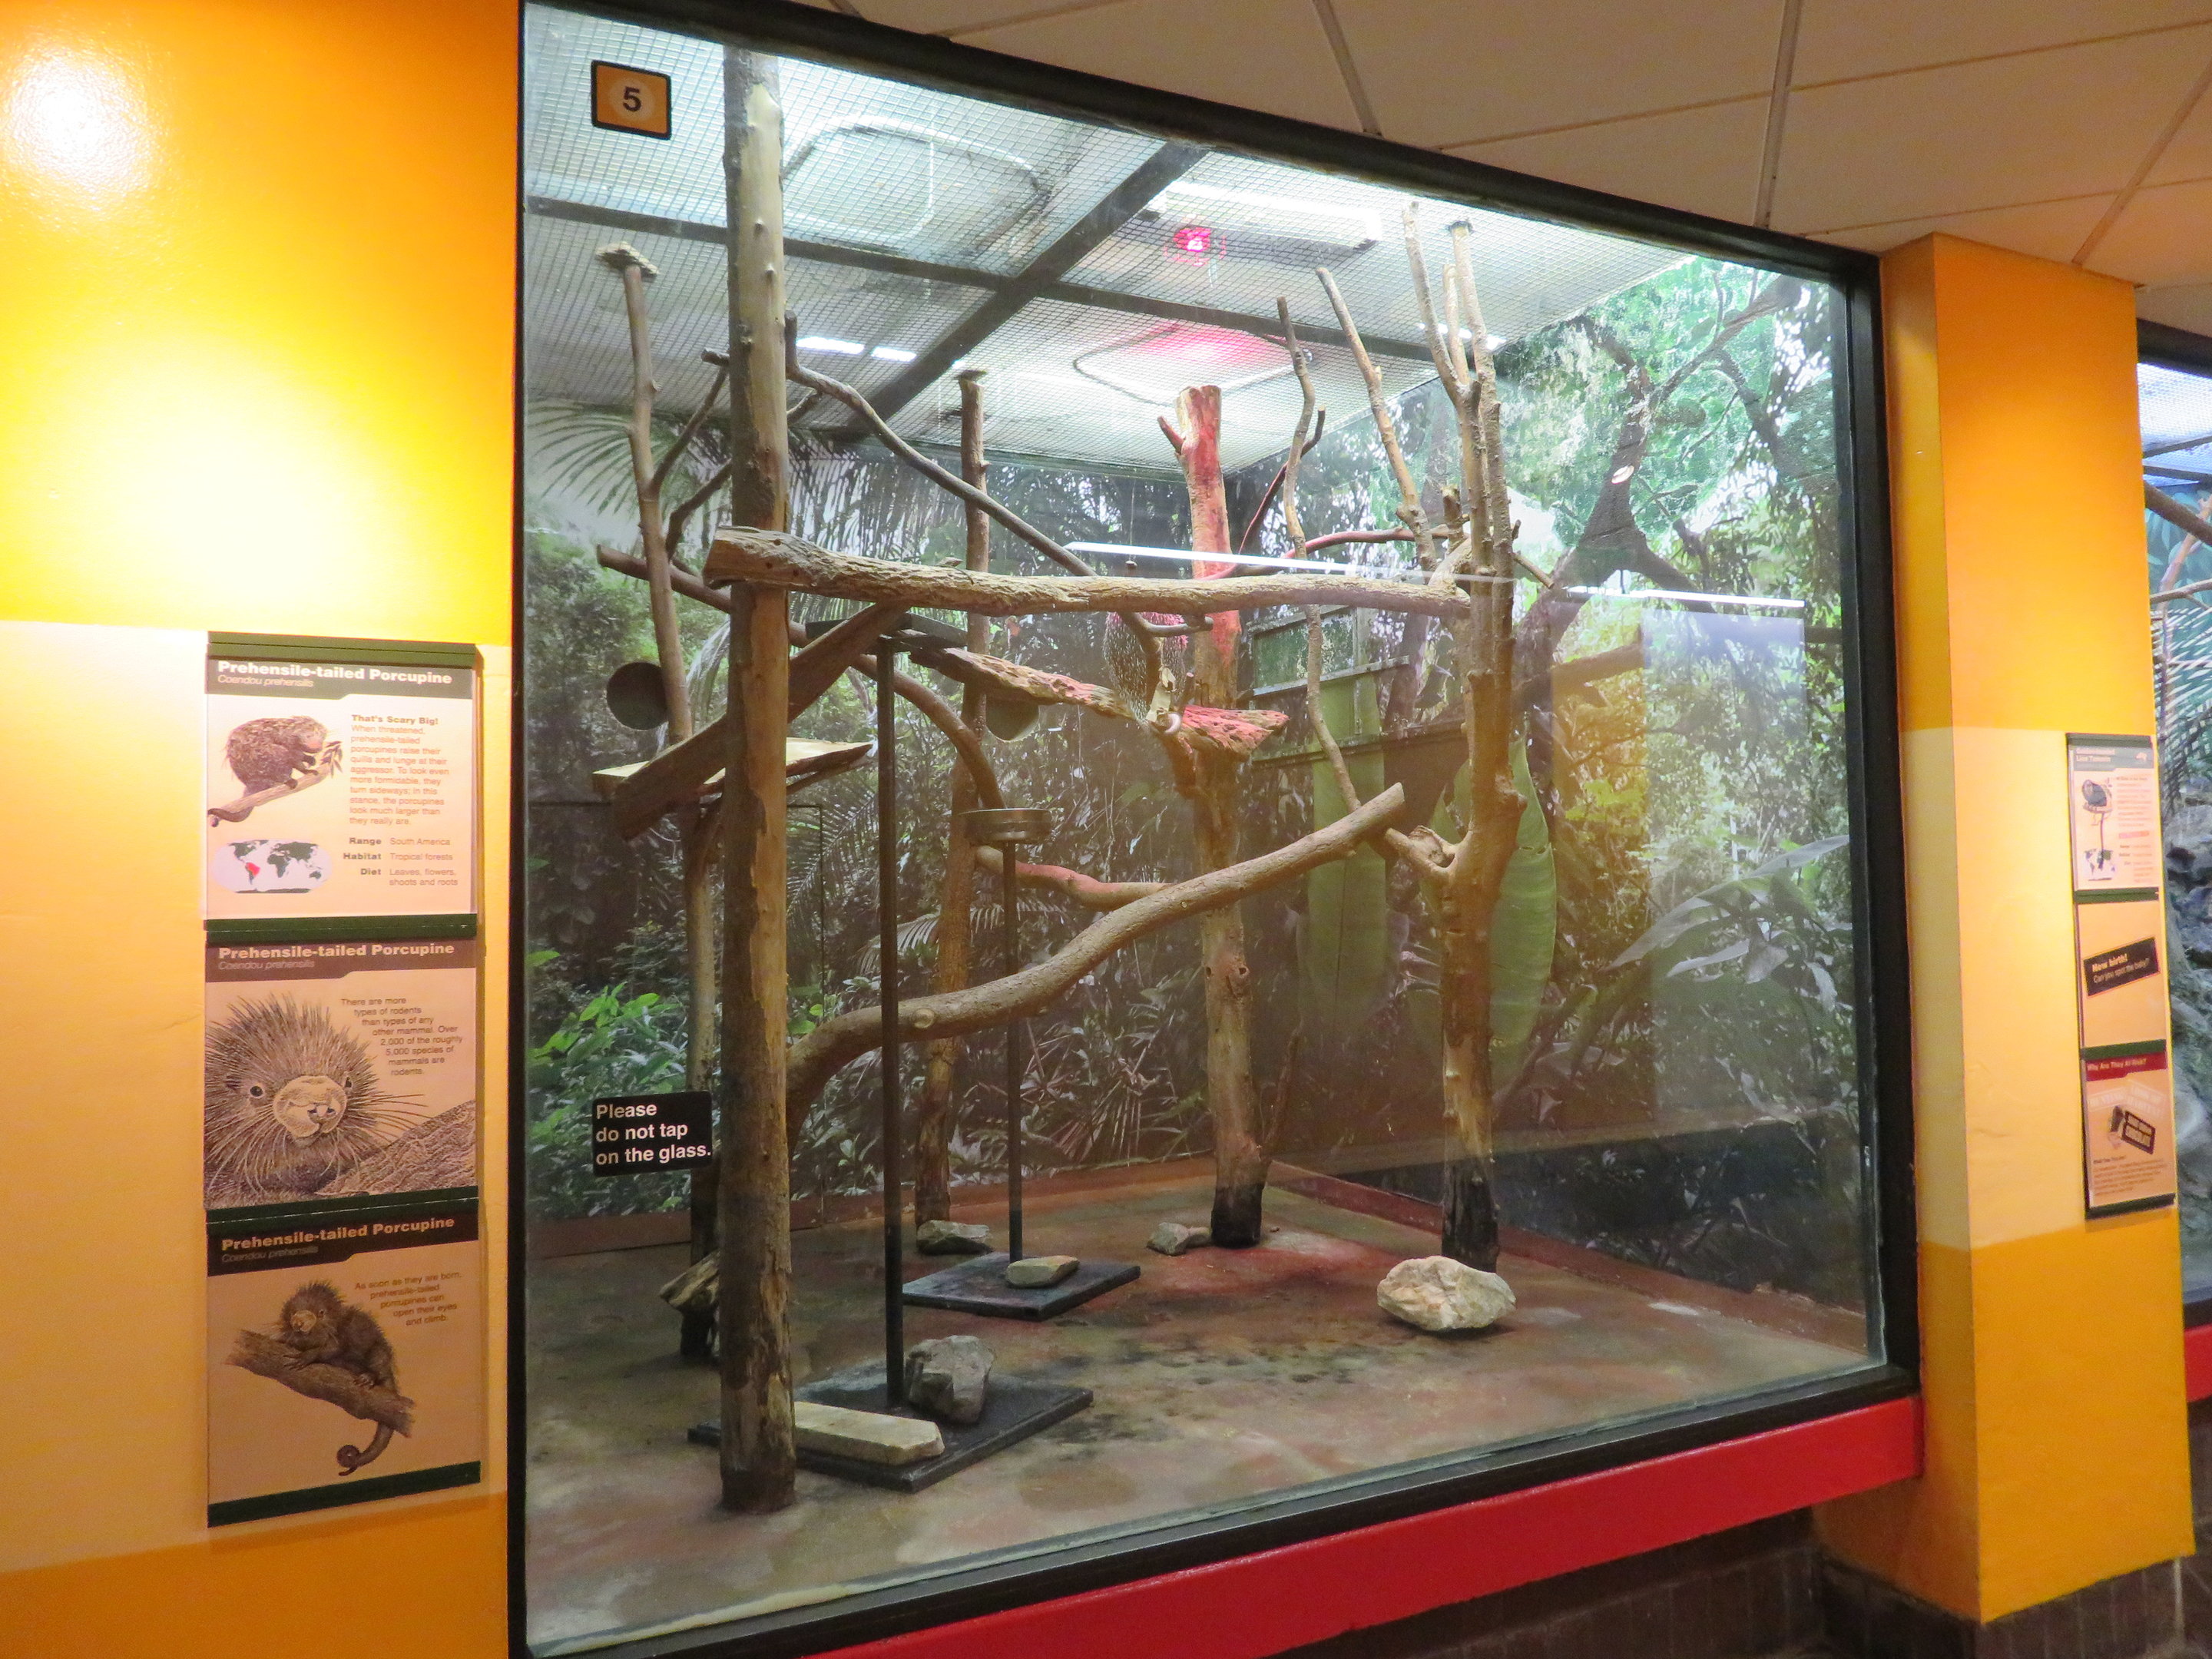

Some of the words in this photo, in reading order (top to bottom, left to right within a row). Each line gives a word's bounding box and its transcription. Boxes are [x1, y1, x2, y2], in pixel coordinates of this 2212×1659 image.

[623, 86, 642, 112] 5
[218, 661, 365, 679] Prehensile-tailed
[369, 668, 453, 684] Porcupine
[352, 714, 383, 723] That's
[386, 716, 416, 725] Scary
[419, 717, 439, 726] Big!
[349, 837, 382, 846] Range
[389, 837, 415, 846] South
[389, 853, 422, 861] Tropical
[218, 945, 367, 959] Prehensile-tailed
[371, 943, 455, 956] Porcupine
[354, 1008, 376, 1017] types
[384, 1018, 406, 1027] types
[419, 1017, 434, 1025] any
[432, 1036, 463, 1045] roughly
[412, 1046, 444, 1055] species
[596, 1104, 657, 1120] Please
[596, 1127, 619, 1142] do
[625, 1124, 654, 1140] not
[660, 1123, 688, 1140] tap
[596, 1151, 618, 1165] on
[625, 1147, 654, 1163] the
[658, 1144, 711, 1164] glass.
[221, 1224, 368, 1250] Prehensile-tailed
[373, 1217, 455, 1235] Porcupine
[404, 1277, 422, 1285] they
